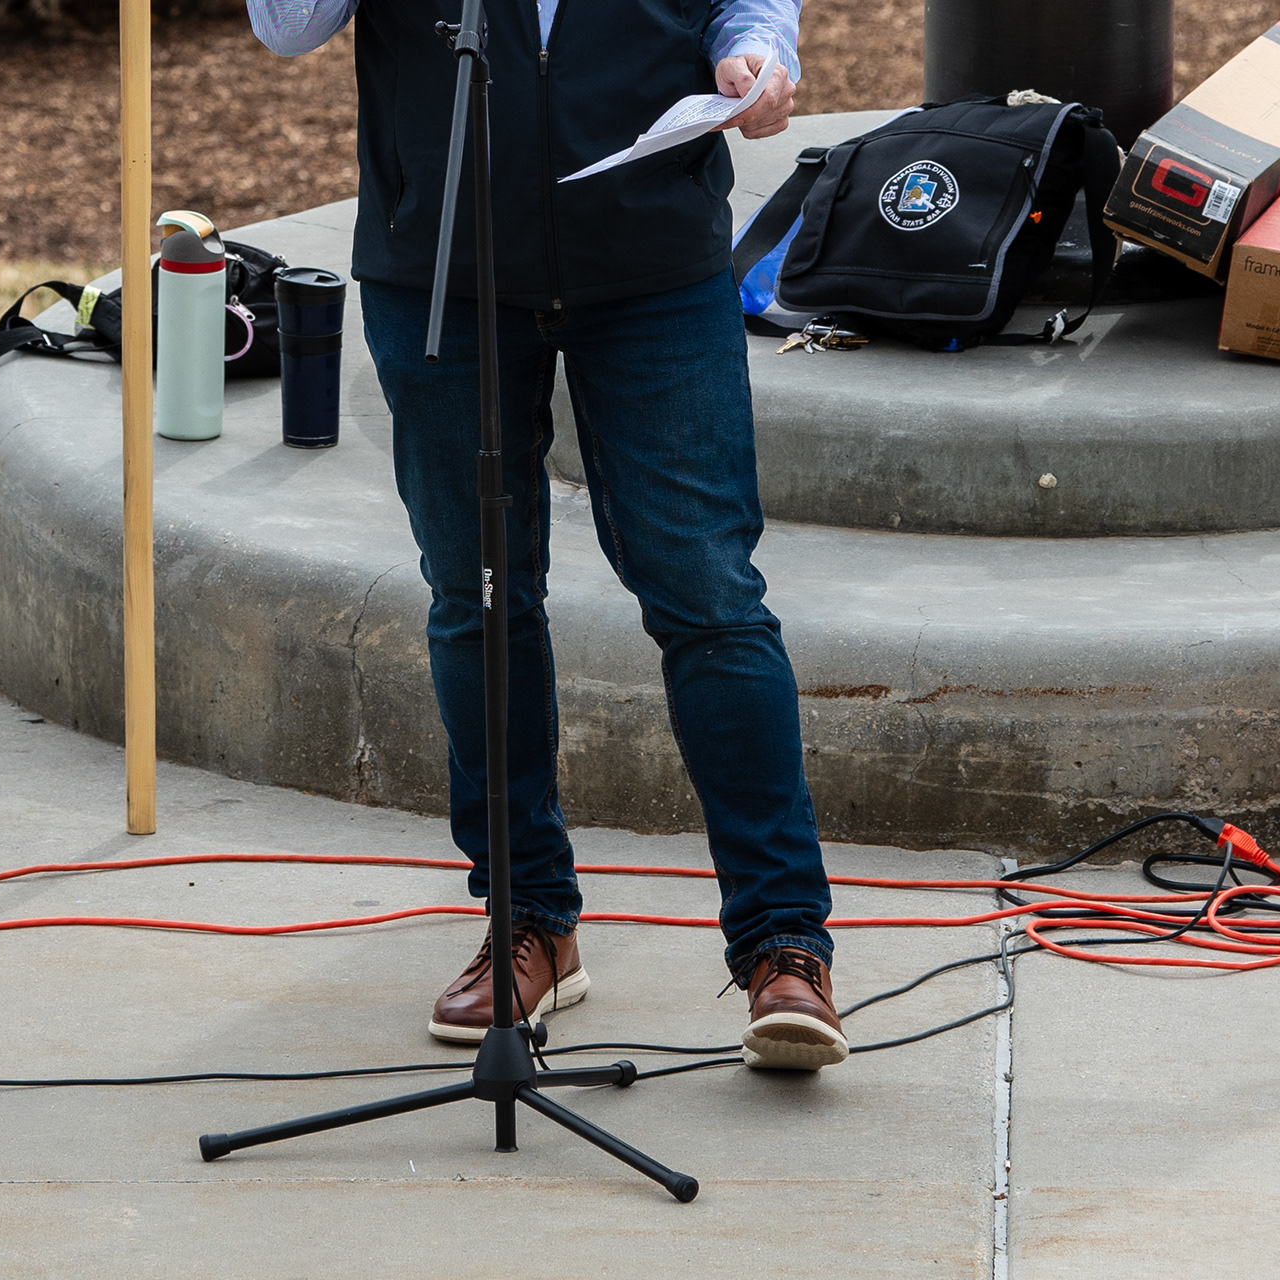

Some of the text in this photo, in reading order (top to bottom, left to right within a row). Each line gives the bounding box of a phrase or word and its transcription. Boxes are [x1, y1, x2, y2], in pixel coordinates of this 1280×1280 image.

[892, 164, 956, 194] PARALEGAL DIVISION
[884, 205, 942, 227] UTAH STATE BAR
[1129, 200, 1202, 237] gatorframeworks.com
